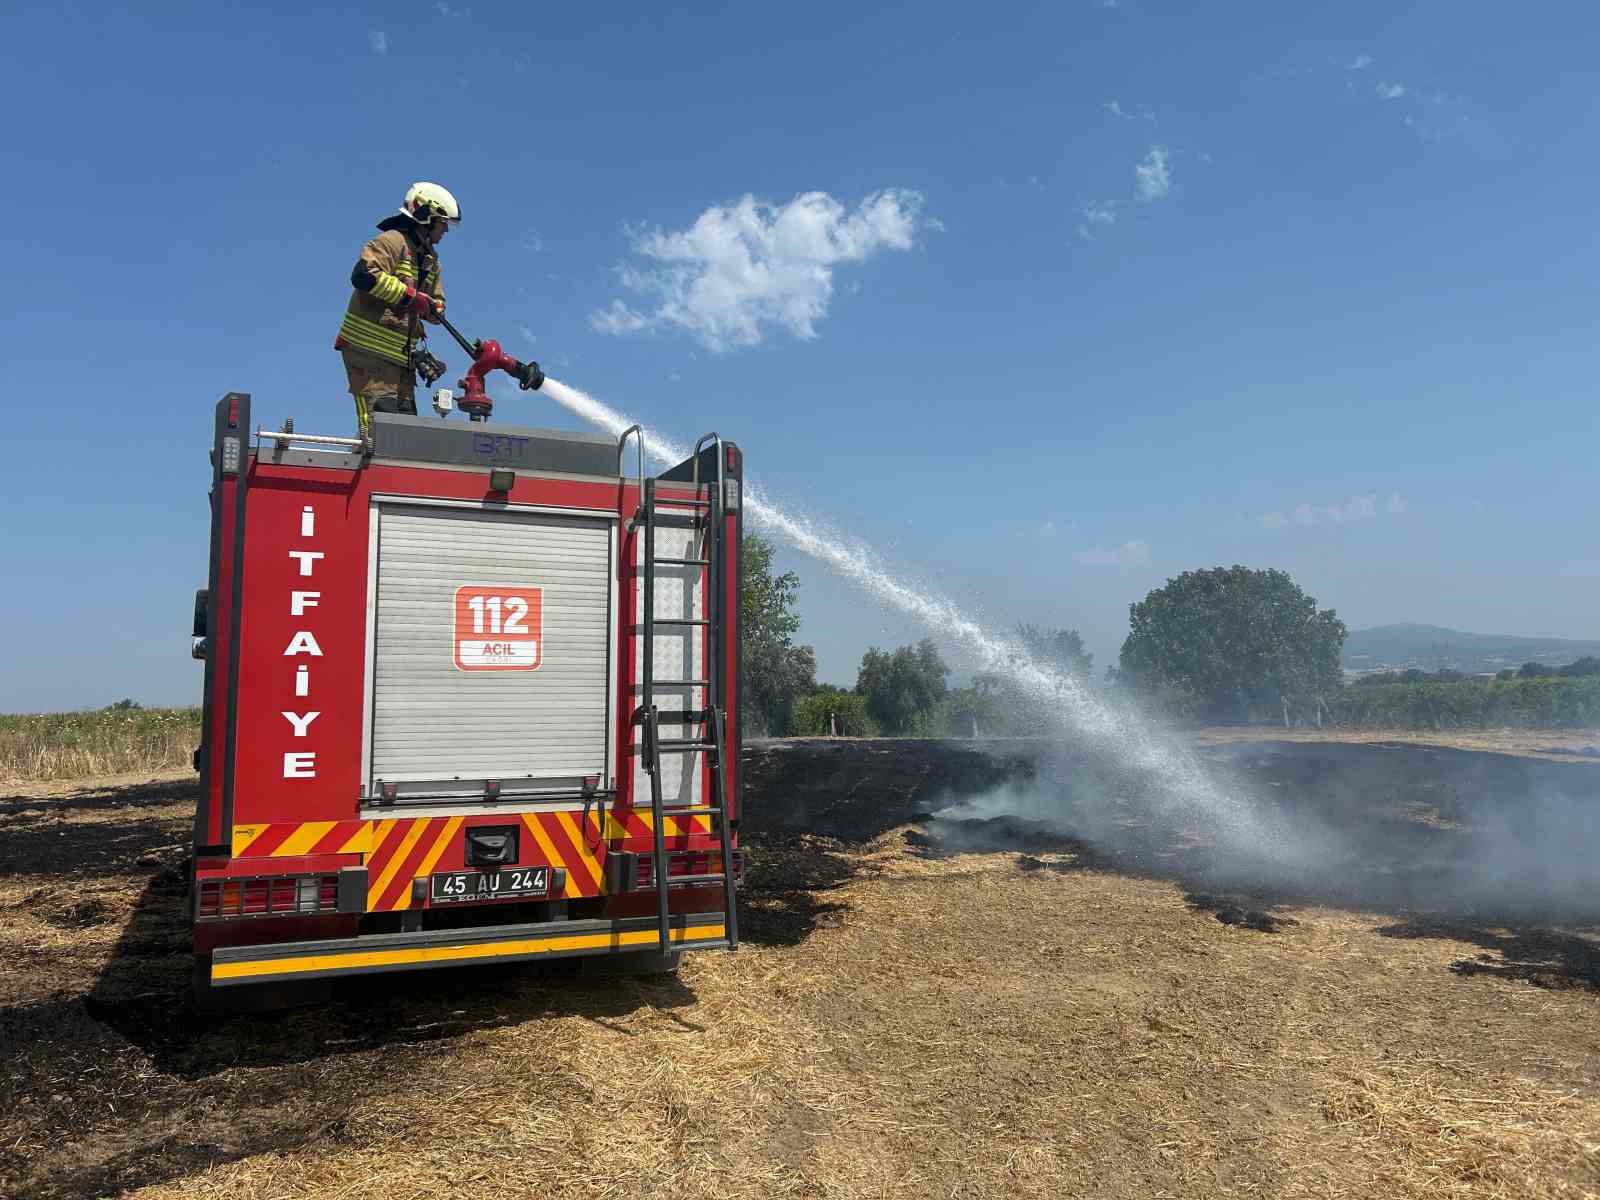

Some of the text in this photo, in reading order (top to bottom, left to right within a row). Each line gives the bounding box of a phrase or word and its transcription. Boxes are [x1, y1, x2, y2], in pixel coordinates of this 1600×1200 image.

[468, 595, 529, 634] 112
[281, 505, 325, 778] İTFAİYE
[443, 870, 545, 895] 45 AU 244
